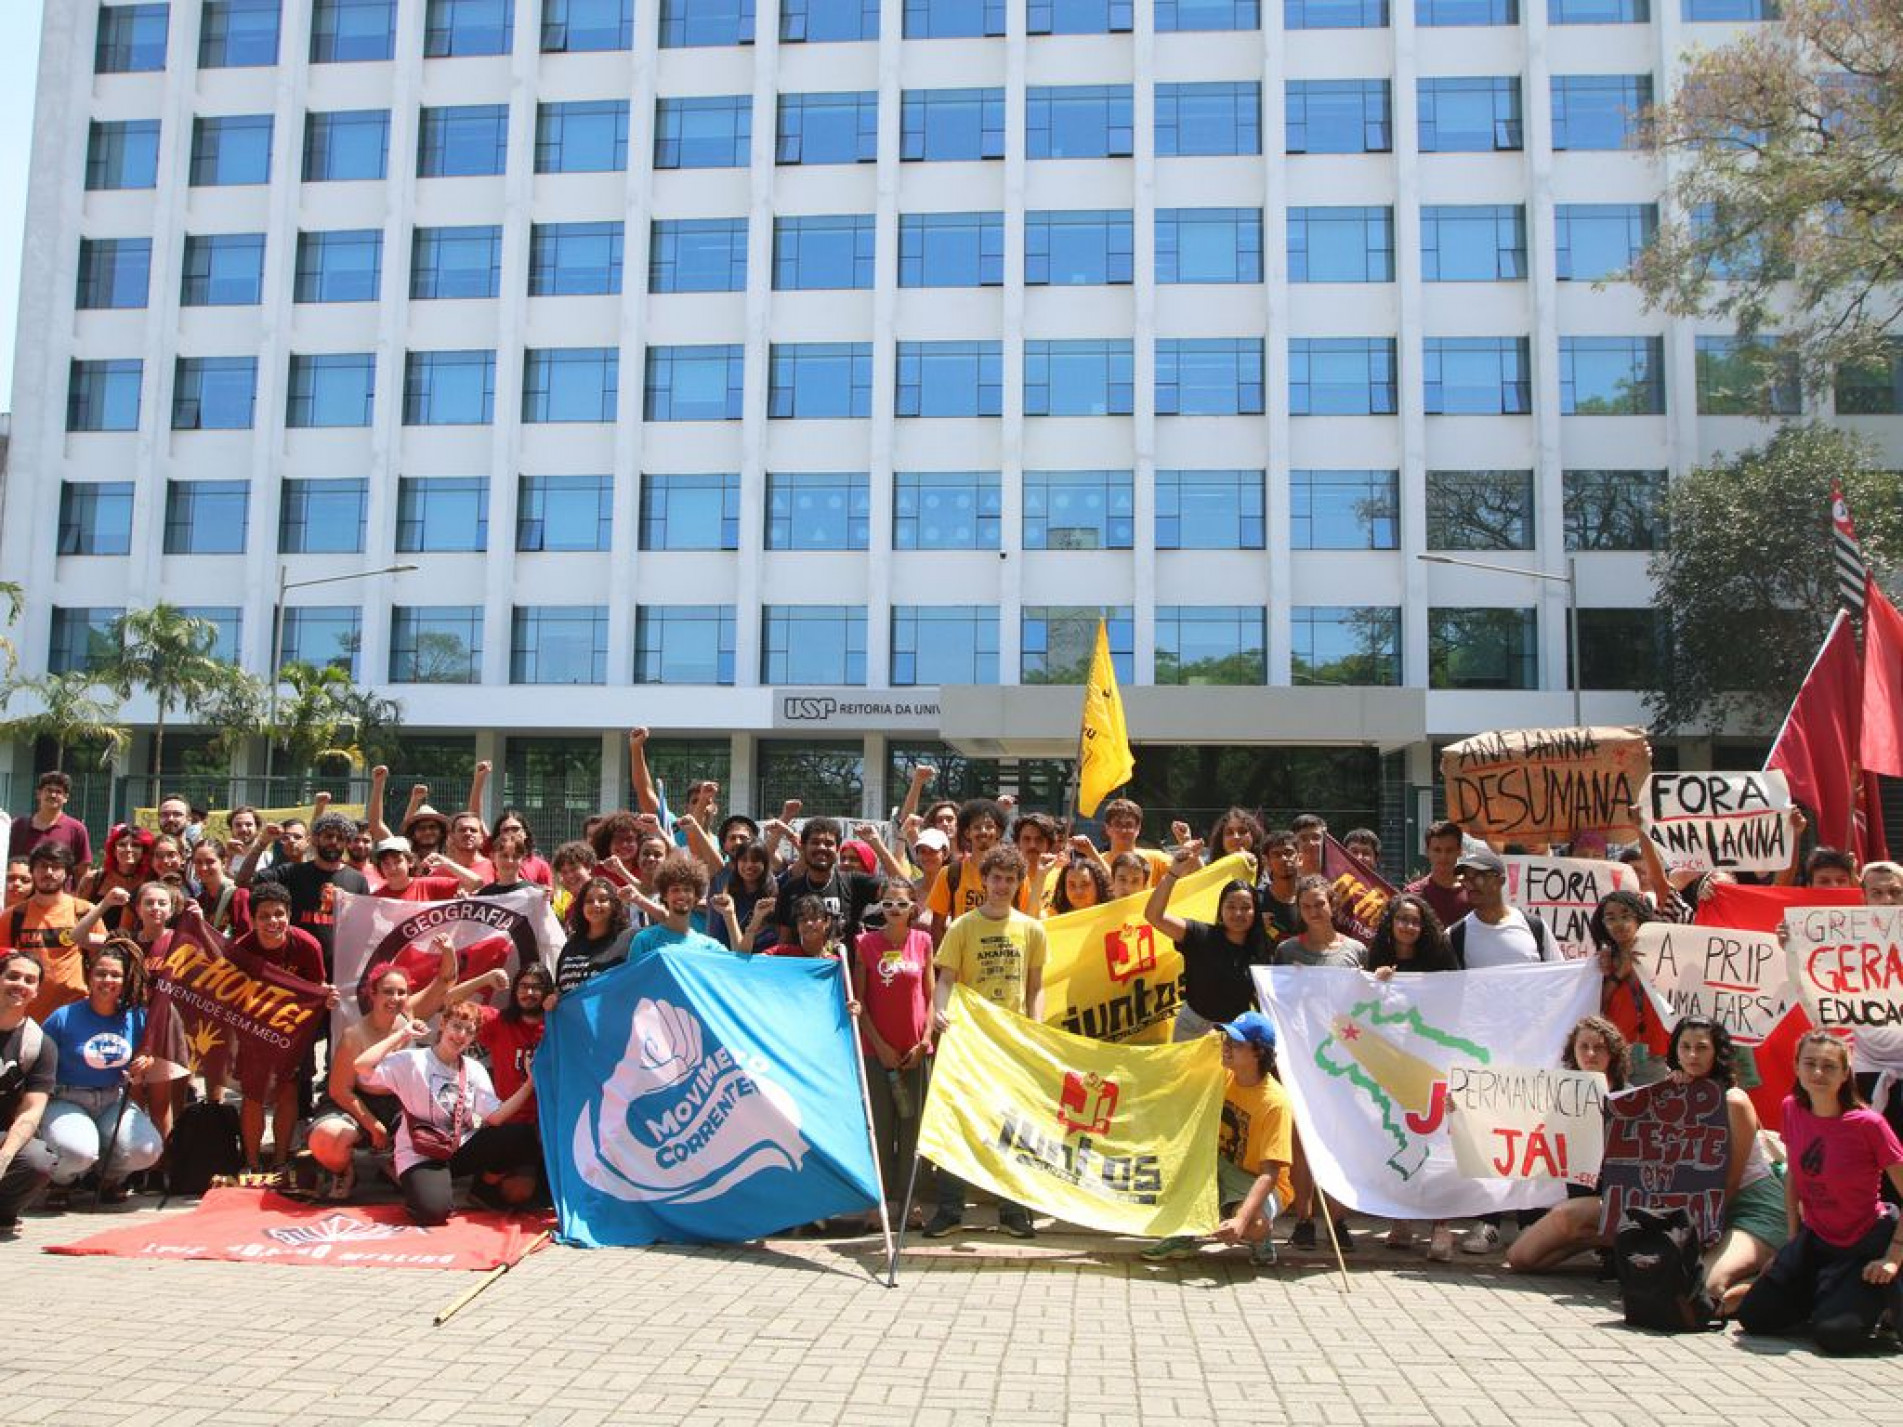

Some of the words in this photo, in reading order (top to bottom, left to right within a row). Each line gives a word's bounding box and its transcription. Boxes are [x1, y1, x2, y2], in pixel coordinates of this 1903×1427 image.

[784, 698, 837, 719] USP
[839, 703, 893, 714] REITORIA
[895, 704, 911, 714] DA
[1459, 734, 1512, 767] ANA
[1522, 731, 1600, 760] LANNA
[1453, 765, 1634, 832] DESUMANA
[1651, 774, 1770, 822] FORA
[1650, 821, 1703, 854] ANA
[1706, 812, 1785, 867] LANNA
[1526, 864, 1600, 904] FORA
[402, 902, 514, 939] GEOGRAFIA
[1552, 906, 1600, 942] LAN
[1656, 932, 1678, 977] A
[1704, 936, 1773, 983] PRIP
[223, 1011, 252, 1031] SEM
[252, 1024, 291, 1050] MEDO
[1818, 997, 1903, 1026] EDUCA
[1493, 1123, 1569, 1179] JÁ!
[1603, 1116, 1727, 1171] LESTE
